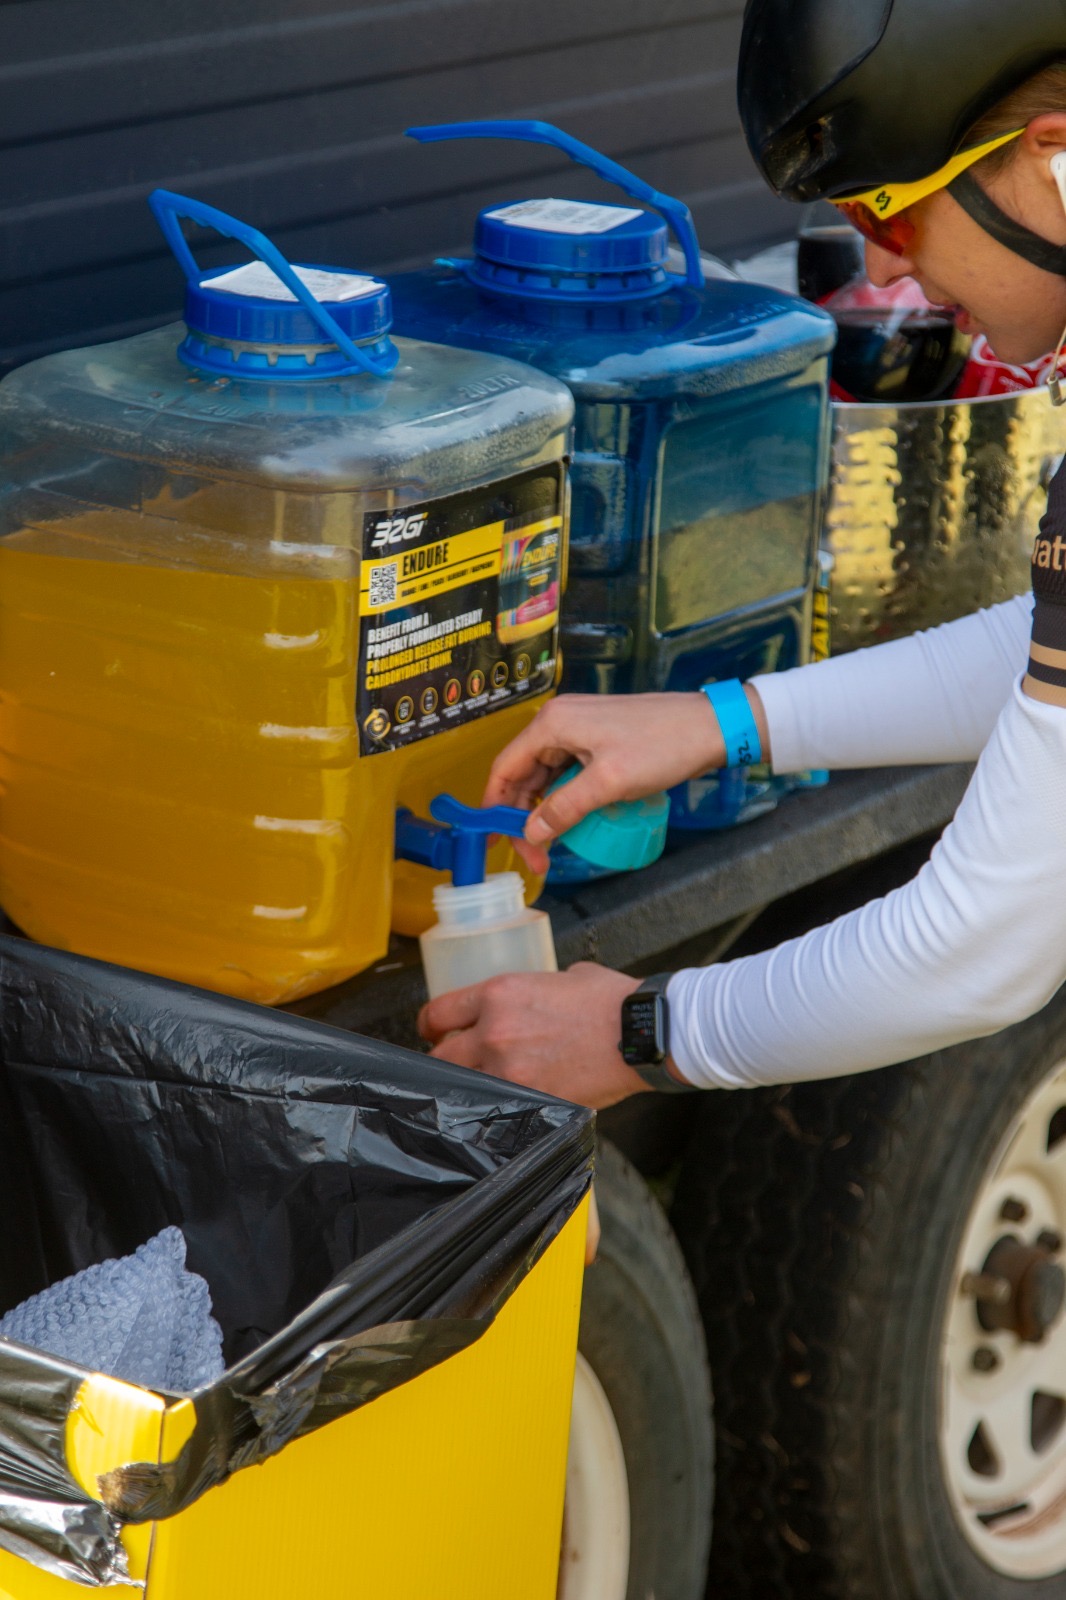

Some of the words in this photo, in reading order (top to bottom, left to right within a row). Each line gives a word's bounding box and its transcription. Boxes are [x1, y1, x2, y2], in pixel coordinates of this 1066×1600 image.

[402, 541, 449, 576] ENDURE
[366, 635, 408, 659] PROPERLY
[408, 618, 455, 648] FORMULATED
[455, 608, 483, 630] STEADY
[368, 622, 401, 643] BENEFIT
[401, 614, 423, 634] FROM
[423, 612, 429, 626] A
[365, 649, 414, 675] PROLONGED
[458, 621, 492, 645] BURNING
[365, 658, 429, 690] CARBOHYDRATE
[428, 650, 452, 671] DRINK
